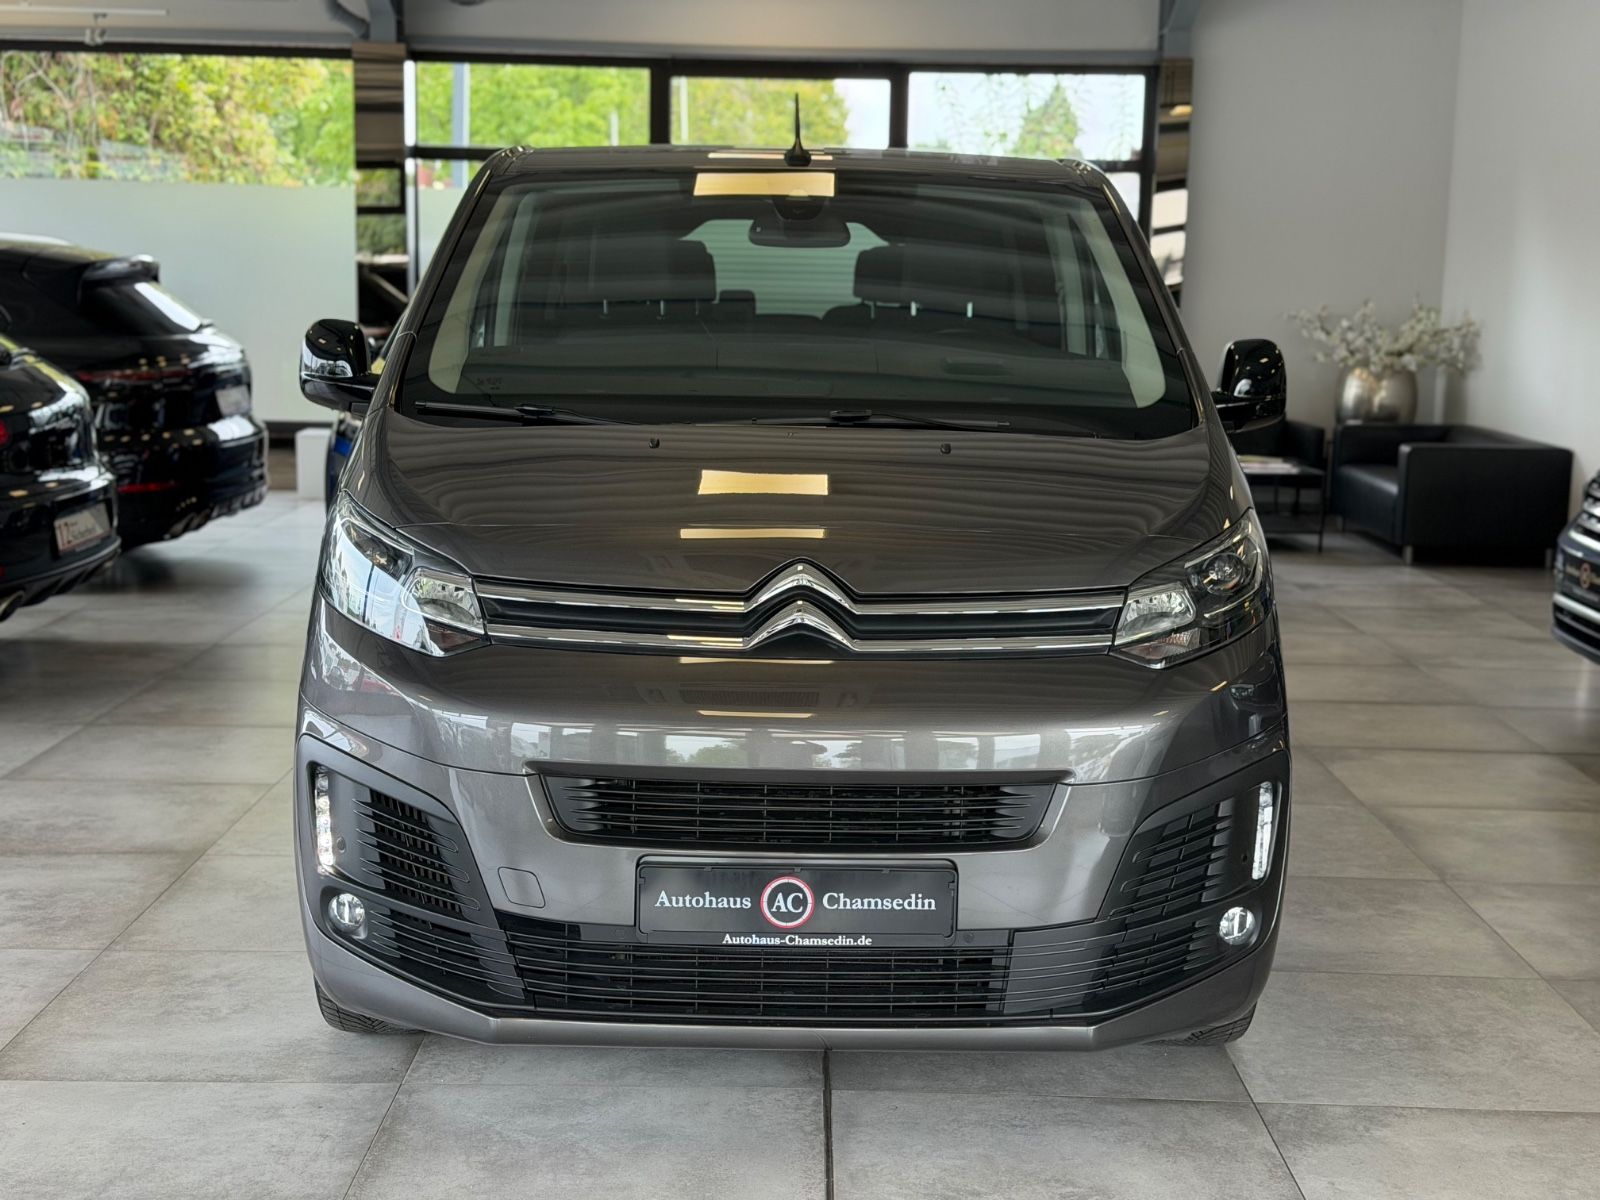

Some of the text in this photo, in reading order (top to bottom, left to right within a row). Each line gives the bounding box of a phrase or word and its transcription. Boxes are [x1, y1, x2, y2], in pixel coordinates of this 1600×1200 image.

[654, 890, 937, 913] Autohaus AC Chamsedin
[722, 933, 873, 947] Autohaus-Chamsedin.de
